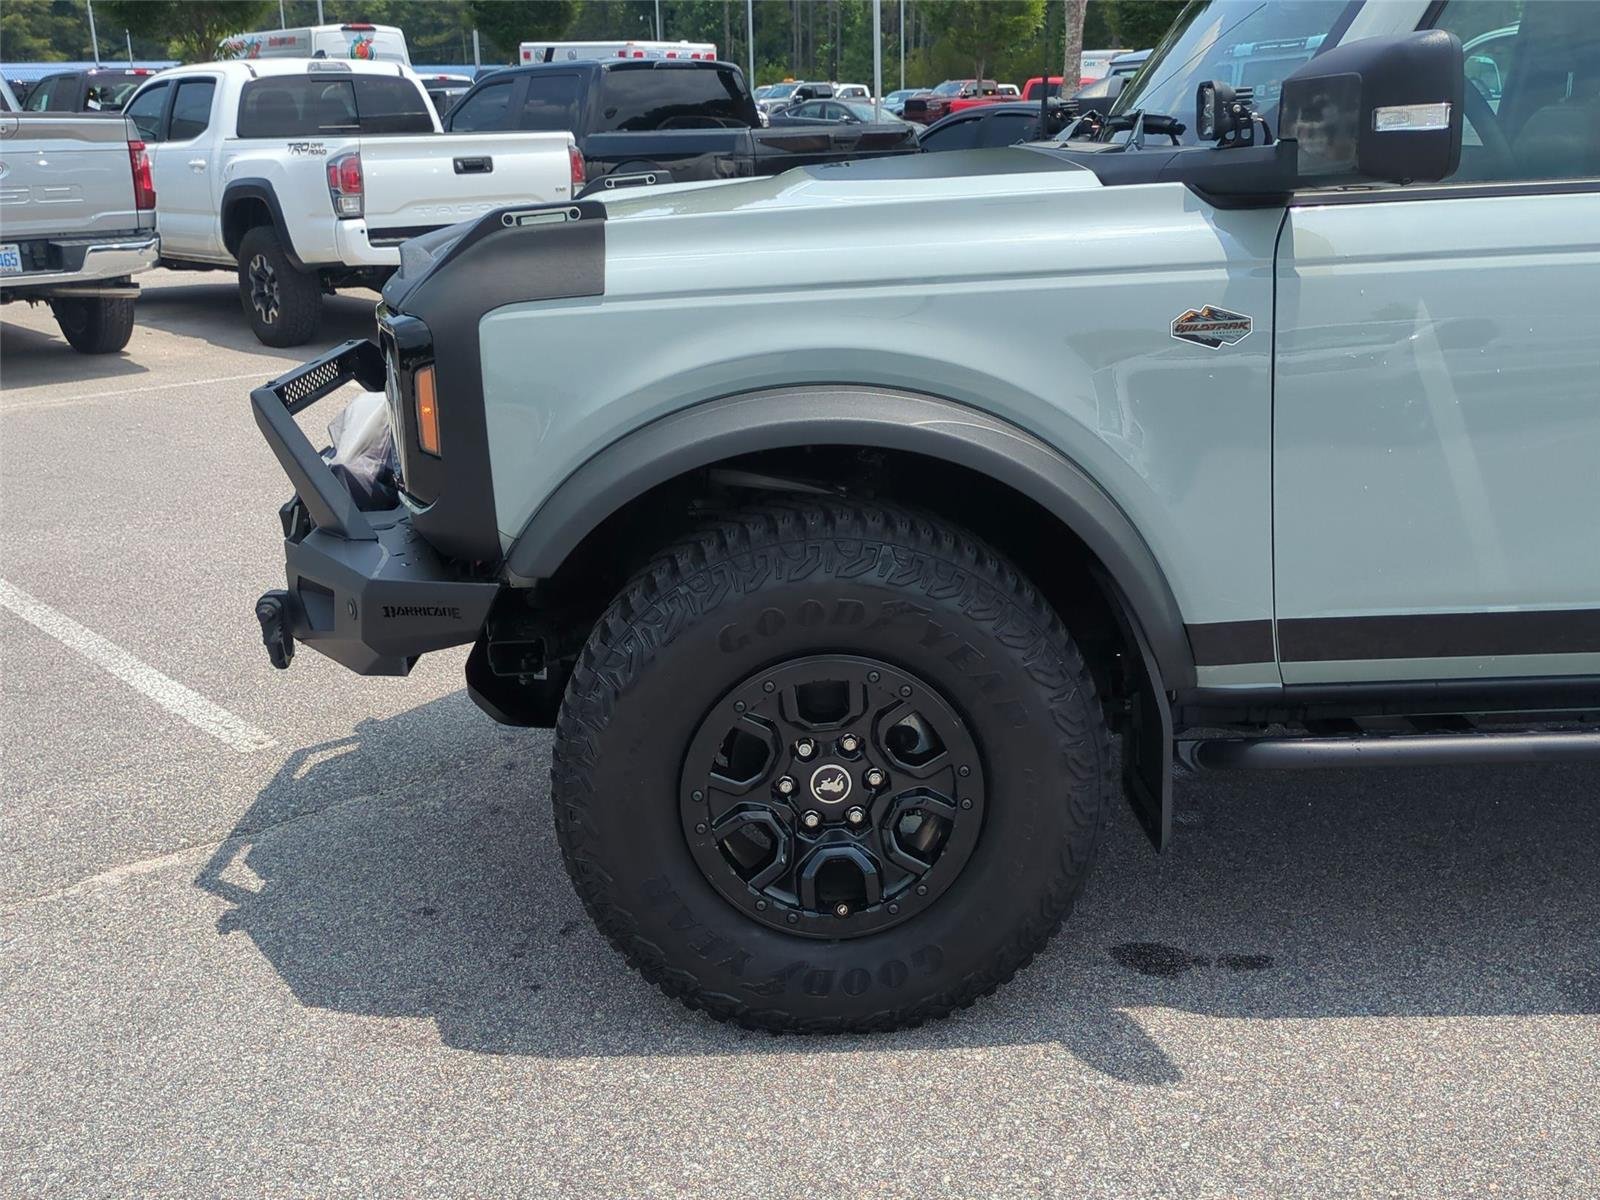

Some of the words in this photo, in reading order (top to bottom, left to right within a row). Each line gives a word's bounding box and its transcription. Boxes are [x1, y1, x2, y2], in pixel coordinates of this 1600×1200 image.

[287, 142, 310, 155] TRD
[1174, 320, 1250, 333] WILDTRAK
[382, 604, 462, 620] BARRICADE
[717, 599, 1031, 729] GOODYEAR
